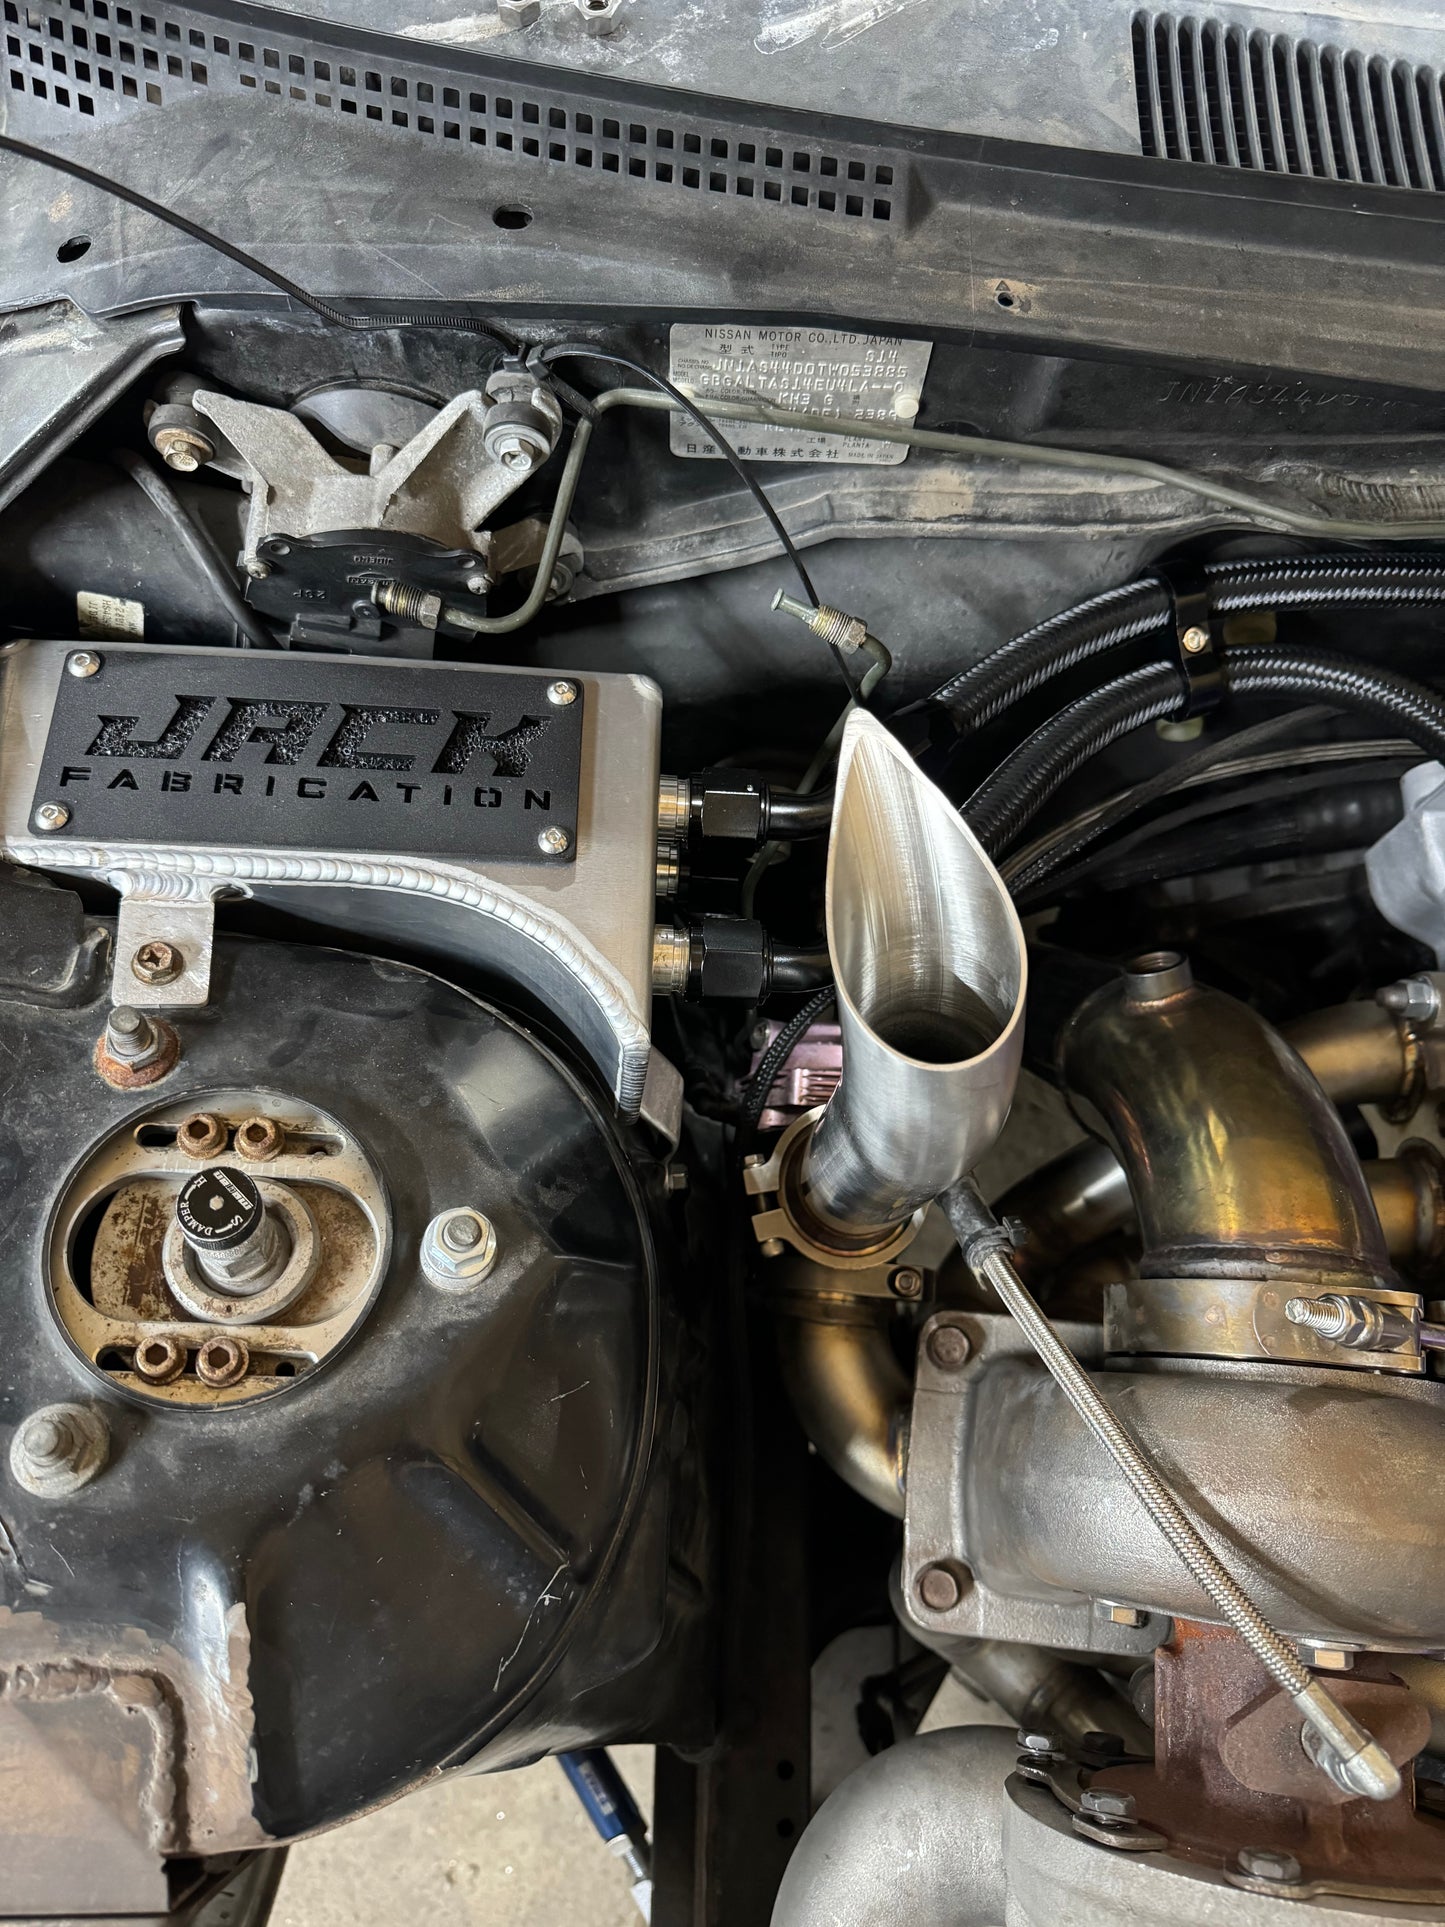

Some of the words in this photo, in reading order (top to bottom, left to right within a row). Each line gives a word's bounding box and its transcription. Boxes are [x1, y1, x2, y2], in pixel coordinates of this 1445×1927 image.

[705, 328, 751, 340] NISSAN
[759, 331, 801, 342] MOTOR
[865, 349, 898, 363] S14
[687, 443, 839, 459] 日産動車株式会社
[84, 693, 553, 778] JACK
[58, 765, 552, 811] FABRICATION
[193, 1174, 208, 1189] H
[180, 1200, 213, 1236] DAMPER
[230, 1214, 244, 1226] S
